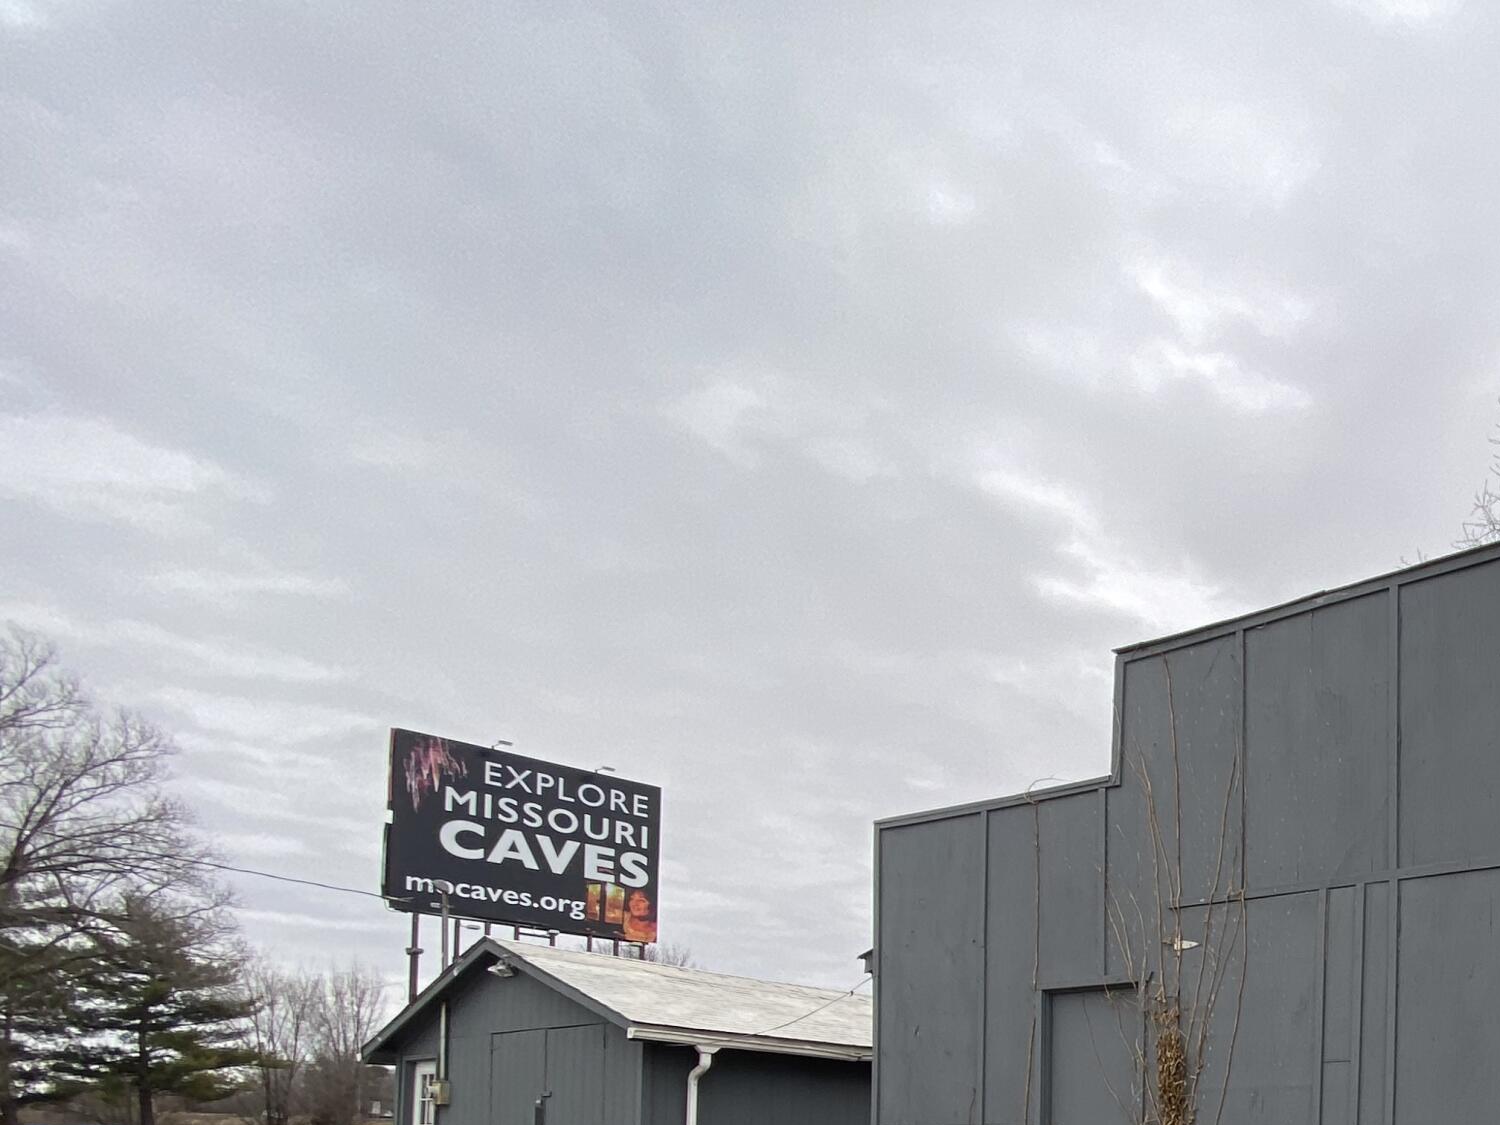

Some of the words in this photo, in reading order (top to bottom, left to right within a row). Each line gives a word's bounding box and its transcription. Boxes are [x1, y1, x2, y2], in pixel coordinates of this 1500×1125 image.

[444, 786, 648, 849] MISSOURI
[484, 761, 649, 818] EXPLORE
[439, 819, 649, 888] CAVES
